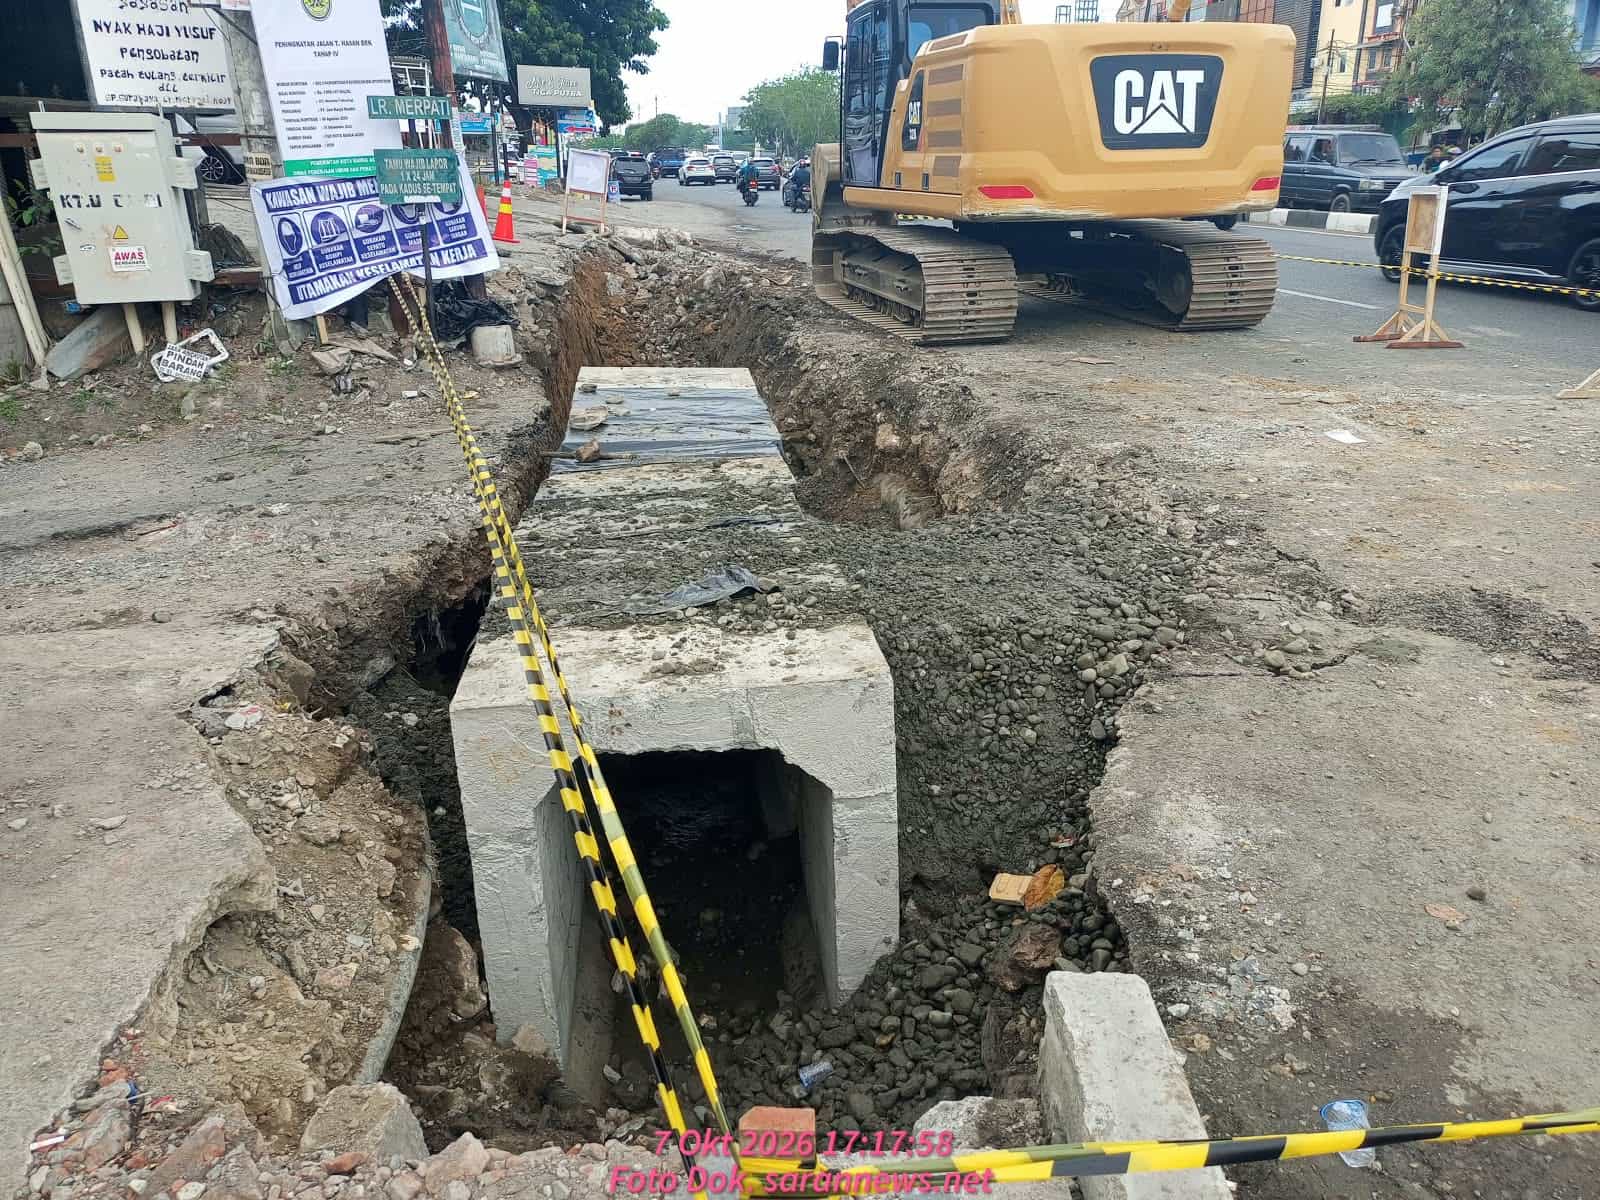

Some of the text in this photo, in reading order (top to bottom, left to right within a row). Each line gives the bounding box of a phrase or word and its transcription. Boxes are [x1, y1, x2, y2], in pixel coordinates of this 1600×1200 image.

[93, 20, 217, 40] NYAK HAJI YUSUF
[370, 99, 450, 116] LR. MERPATI
[1114, 69, 1205, 135] CAT
[908, 101, 921, 125] CAT
[384, 159, 403, 170] TAMU
[405, 159, 427, 170] WAJIB
[427, 158, 449, 169] LAPOR
[423, 171, 435, 181] JAM
[265, 186, 317, 209] KAWASAN
[317, 182, 357, 200] WAJIB
[381, 184, 398, 195] PADA
[400, 184, 422, 194] KADUS
[114, 252, 144, 261] AWAS
[355, 251, 440, 279] KESELAMATN
[441, 244, 477, 265] KERJA
[161, 359, 202, 377] BARANG
[166, 350, 204, 369] PINDAH
